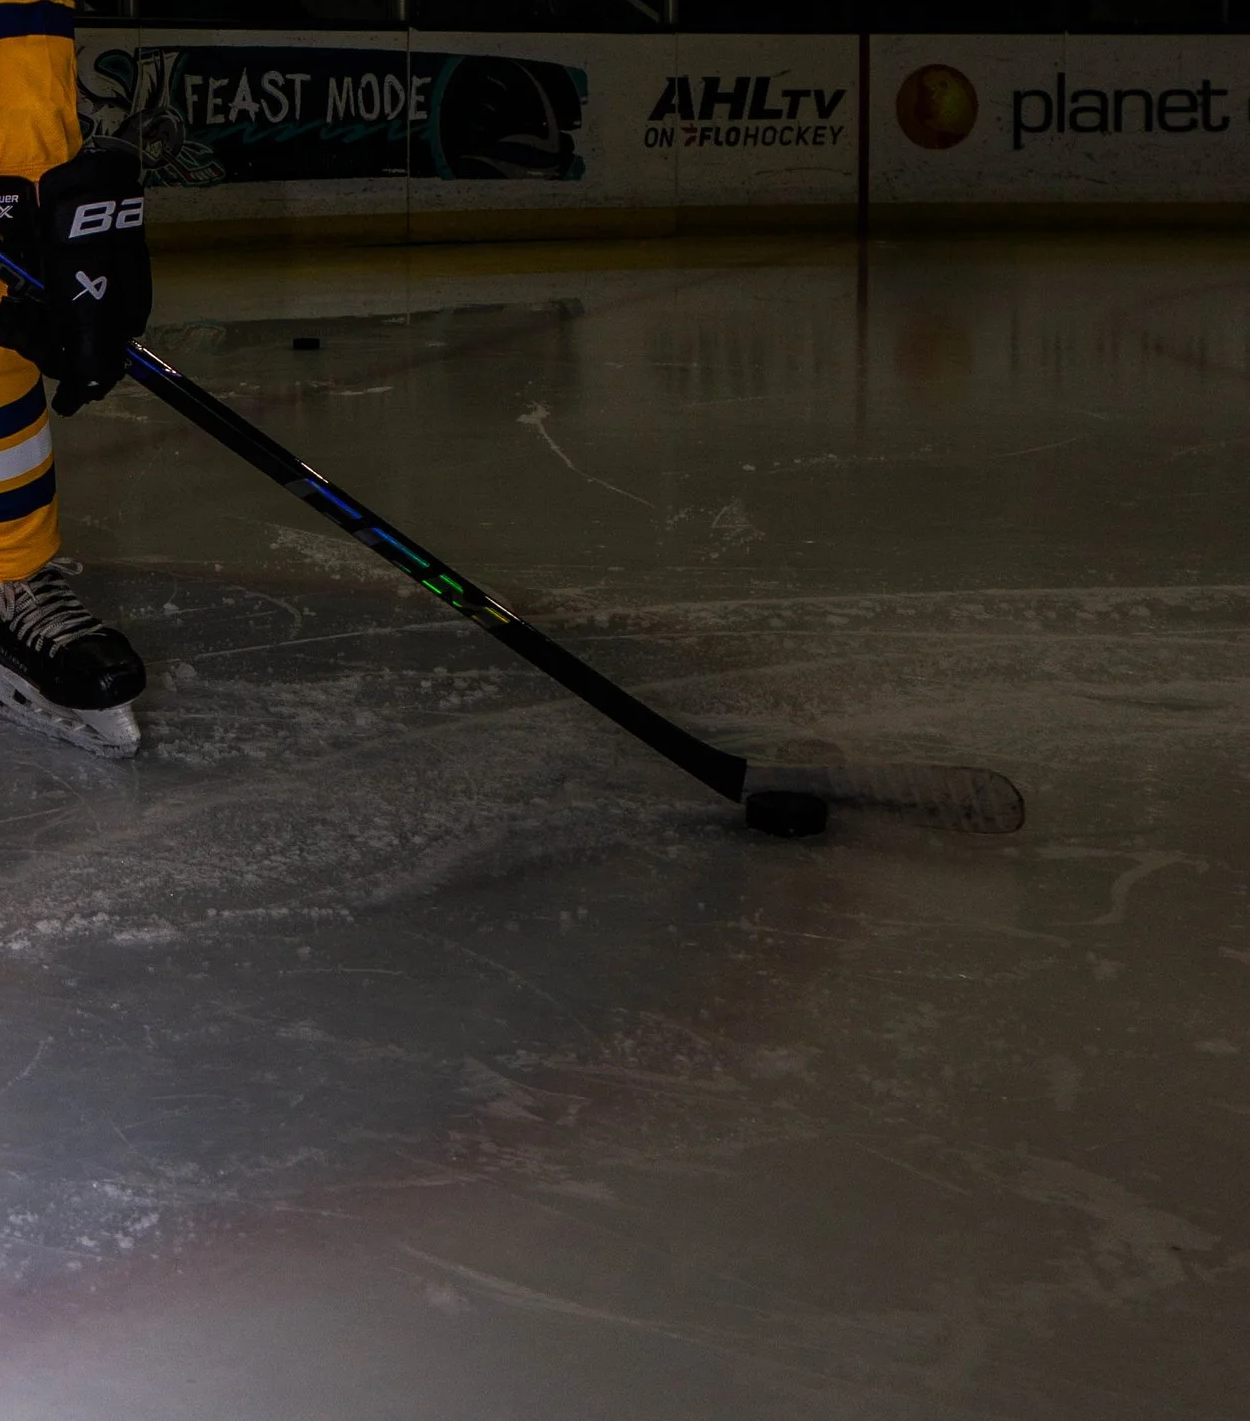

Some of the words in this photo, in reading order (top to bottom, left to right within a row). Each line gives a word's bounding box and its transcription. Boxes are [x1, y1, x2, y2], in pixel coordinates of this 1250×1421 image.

[183, 66, 311, 126] FEAST
[326, 72, 433, 126] MODE
[1012, 72, 1230, 150] planet
[643, 126, 675, 149] ON
